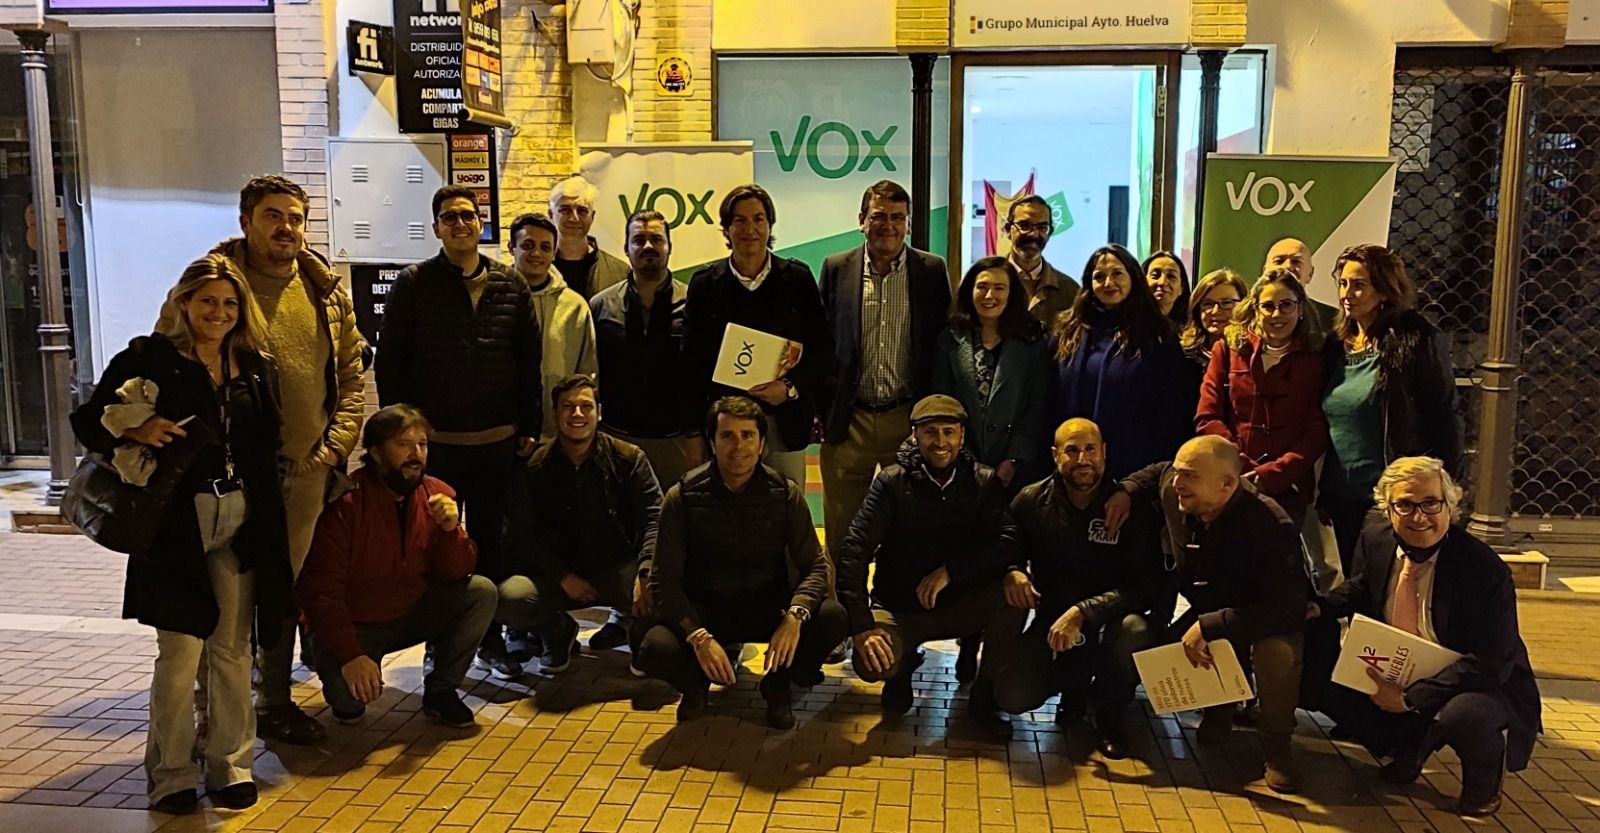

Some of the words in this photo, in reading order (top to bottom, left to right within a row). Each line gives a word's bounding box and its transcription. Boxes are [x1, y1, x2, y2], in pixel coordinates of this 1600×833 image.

[410, 14, 462, 27] networ
[985, 18, 1023, 30] Grupo
[1026, 16, 1088, 29] Municipal
[1091, 16, 1122, 29] Ayto.
[1126, 15, 1169, 27] Huelva
[356, 27, 378, 60] fi
[410, 42, 464, 52] DISTRIBUID
[354, 58, 384, 69] network
[425, 56, 462, 65] OFICIAL
[413, 69, 461, 79] AUTORIZA
[421, 88, 463, 100] ACUMULA
[422, 103, 465, 114] COMPART
[433, 117, 459, 129] GIGAS
[453, 139, 485, 150] orange
[770, 115, 898, 179] VOX
[456, 173, 485, 183] yoigo
[1225, 171, 1315, 216] VOX
[618, 183, 715, 230] VOX
[1050, 200, 1065, 229] VOX
[733, 340, 755, 375] VOX
[1386, 646, 1410, 684] MUEBLES
